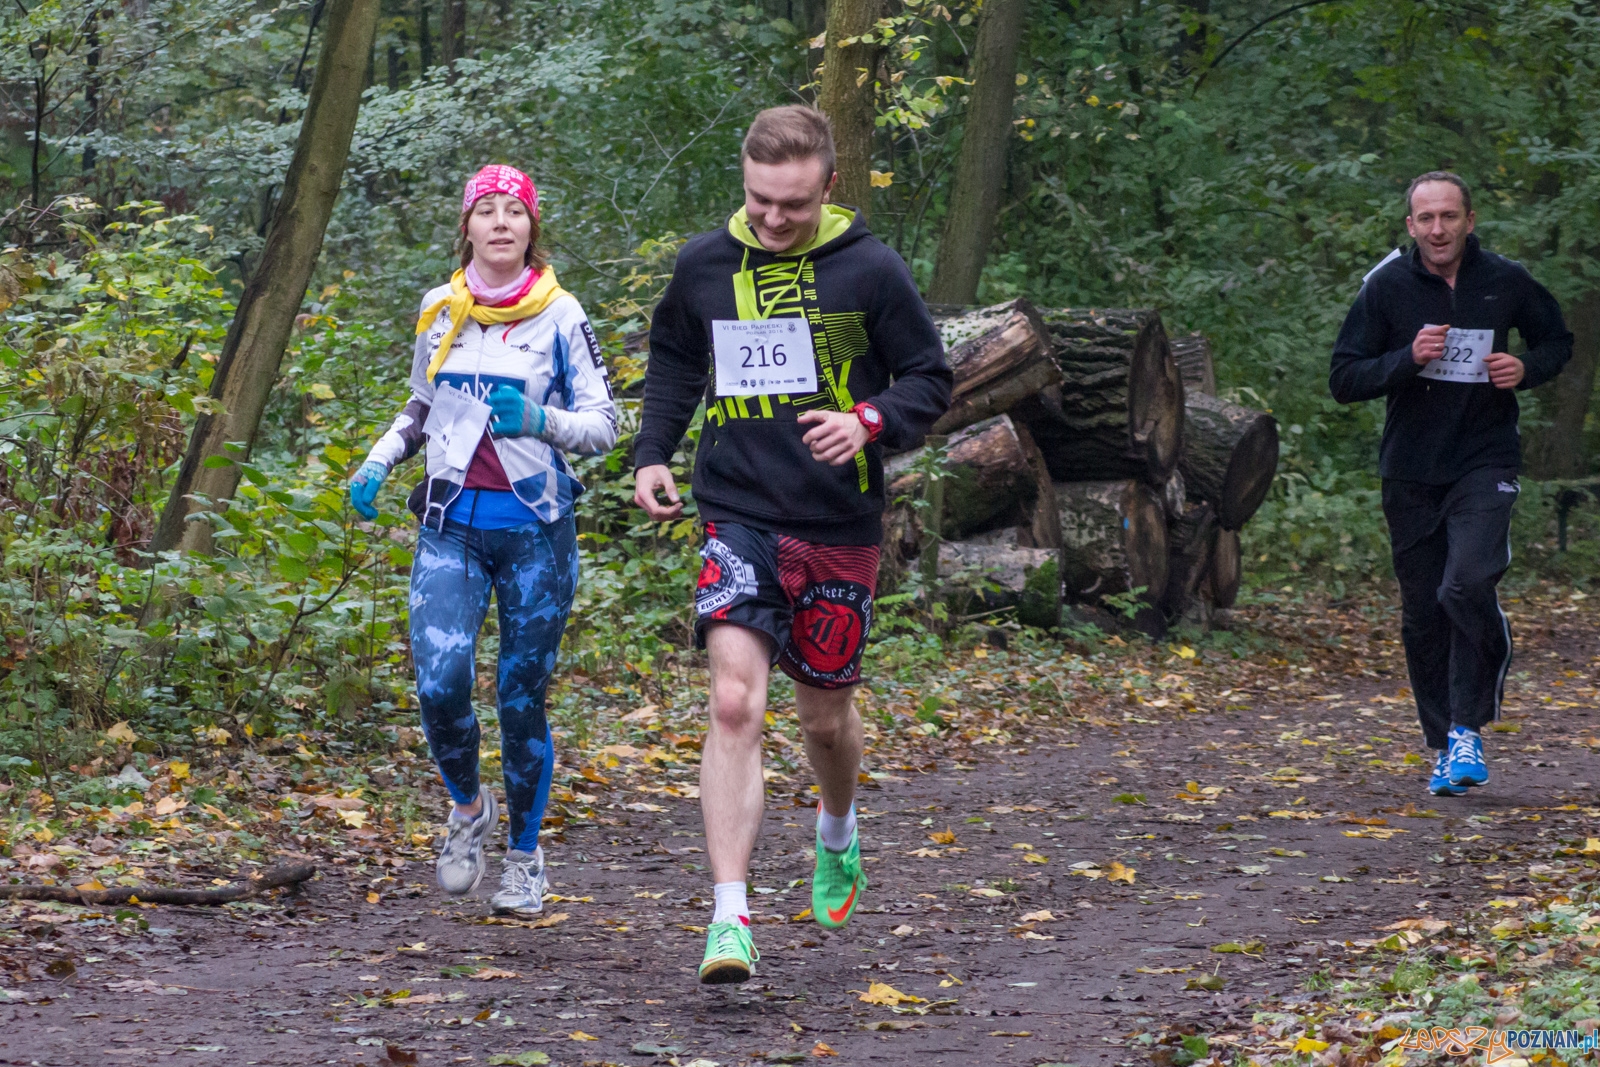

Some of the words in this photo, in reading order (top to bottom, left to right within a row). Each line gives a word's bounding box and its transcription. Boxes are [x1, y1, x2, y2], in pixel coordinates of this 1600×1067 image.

[804, 289, 817, 300] UP
[807, 307, 823, 325] THE
[740, 344, 787, 368] 216
[813, 331, 832, 369] VOLUME
[1440, 346, 1473, 364] 222
[720, 546, 744, 579] COAST
[701, 589, 732, 610] EIGHTY
